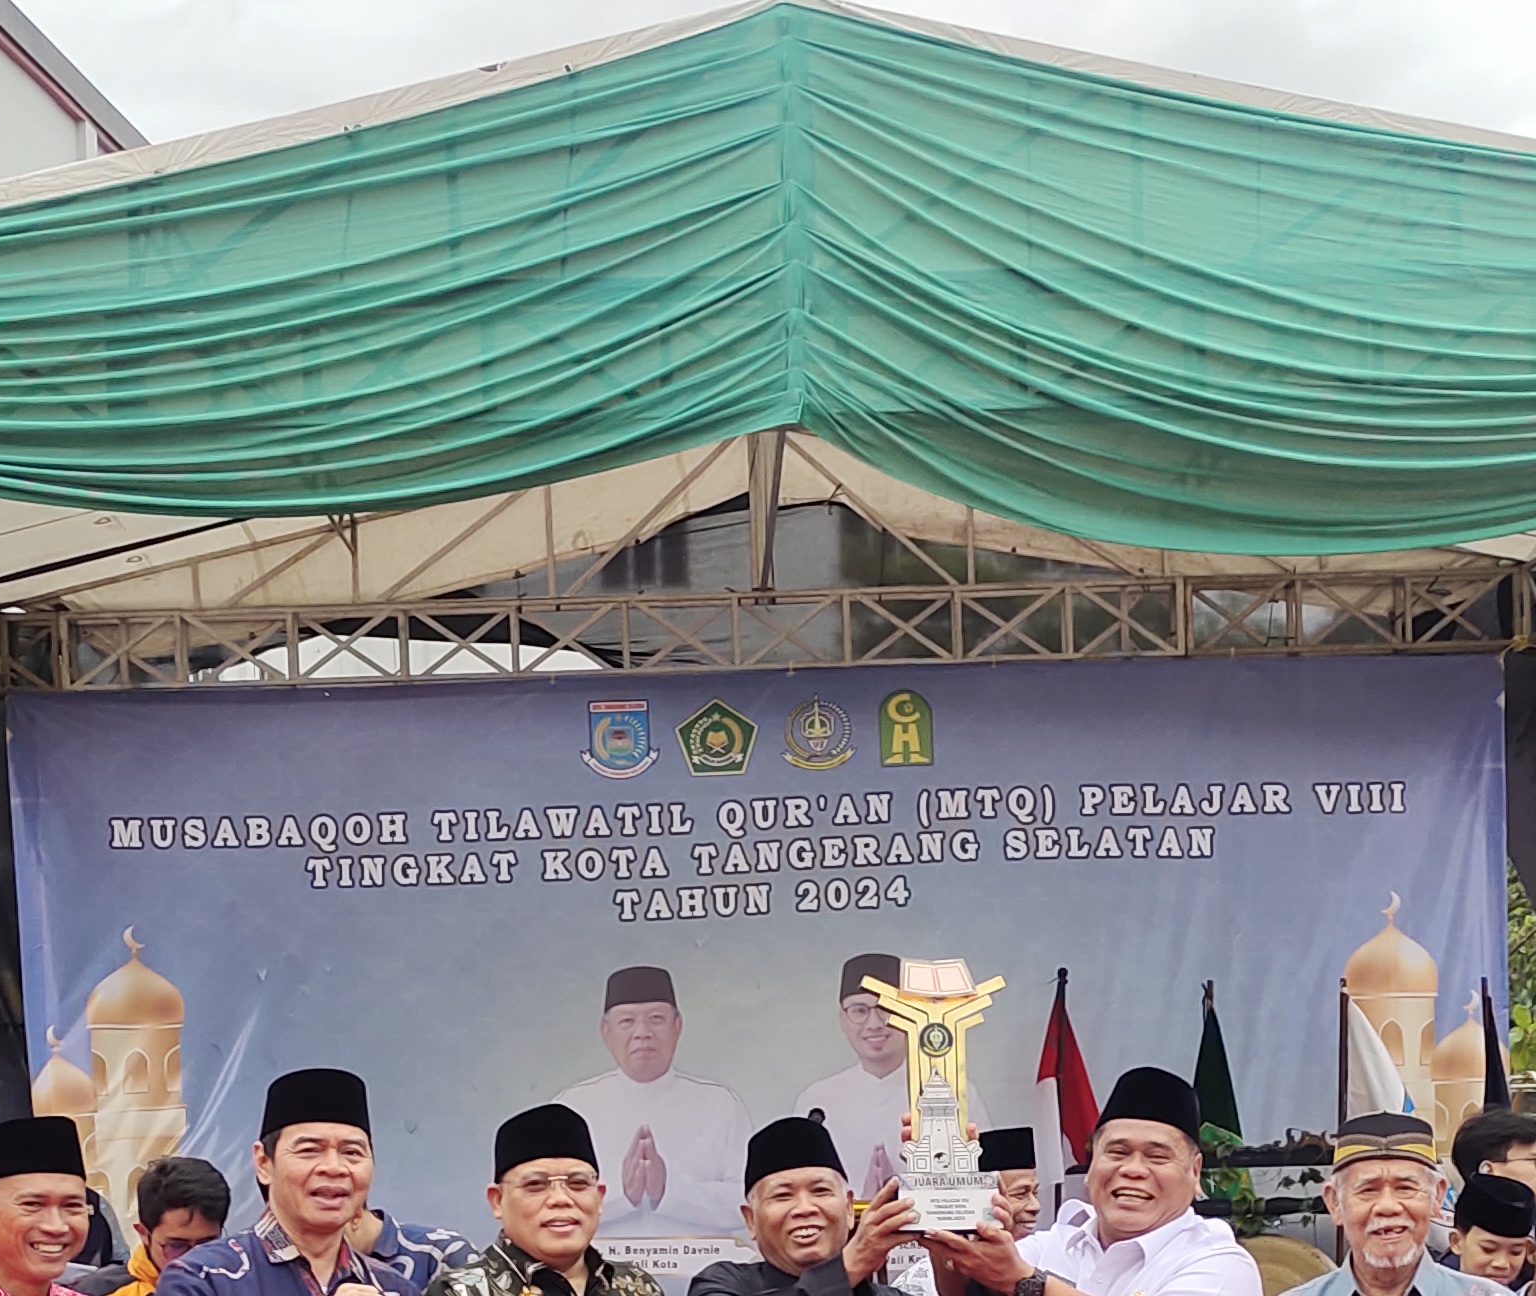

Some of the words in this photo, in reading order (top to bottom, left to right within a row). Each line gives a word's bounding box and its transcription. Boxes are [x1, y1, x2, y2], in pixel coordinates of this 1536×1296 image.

[110, 812, 409, 853] MUSABAQOH
[431, 802, 695, 844] TILAWATIL
[716, 792, 893, 838] QUR'AN
[917, 785, 1057, 824] (MTQ)
[1079, 782, 1293, 817] PELAJAR
[1314, 782, 1408, 814] VIII
[306, 850, 518, 889] TINGKAT
[542, 845, 670, 883] KOTA
[693, 830, 981, 875] TANGERANG
[1004, 825, 1216, 861] SELATAN
[612, 883, 773, 923] TAHUN
[795, 876, 912, 914] 2024
[914, 1177, 946, 1187] JUARA
[948, 1176, 984, 1187] UMUM
[625, 1245, 679, 1258] Benyamin
[652, 1259, 678, 1269] Kota
